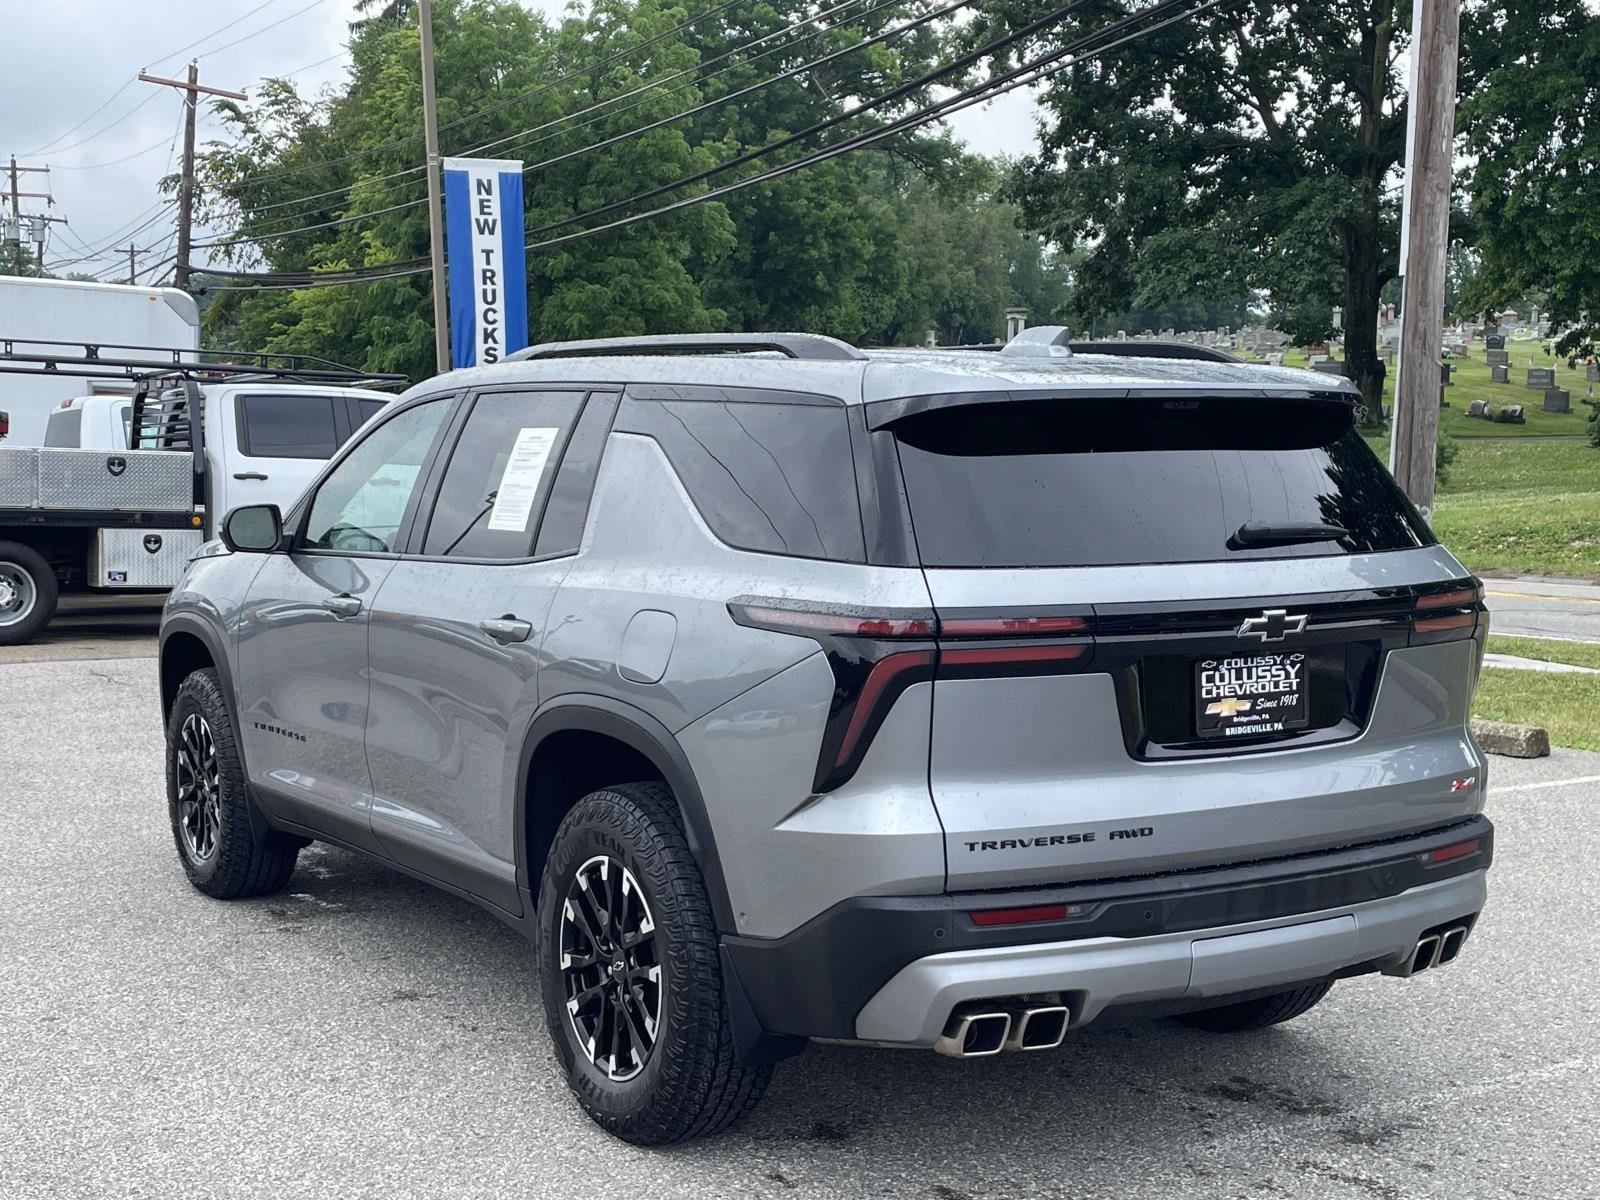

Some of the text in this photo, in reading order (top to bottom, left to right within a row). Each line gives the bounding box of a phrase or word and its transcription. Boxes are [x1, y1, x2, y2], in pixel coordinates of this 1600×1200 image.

[475, 178, 499, 365] NEW TRUCKS
[1223, 655, 1284, 669] COLUSSY
[1201, 663, 1301, 687] COLUSSY
[1201, 679, 1301, 698] CHEVROLET
[1256, 694, 1299, 709] Since 1918
[254, 722, 306, 742] TRAVERSE
[1274, 722, 1284, 731] PA
[964, 826, 1154, 852] TRAVERSE AWD
